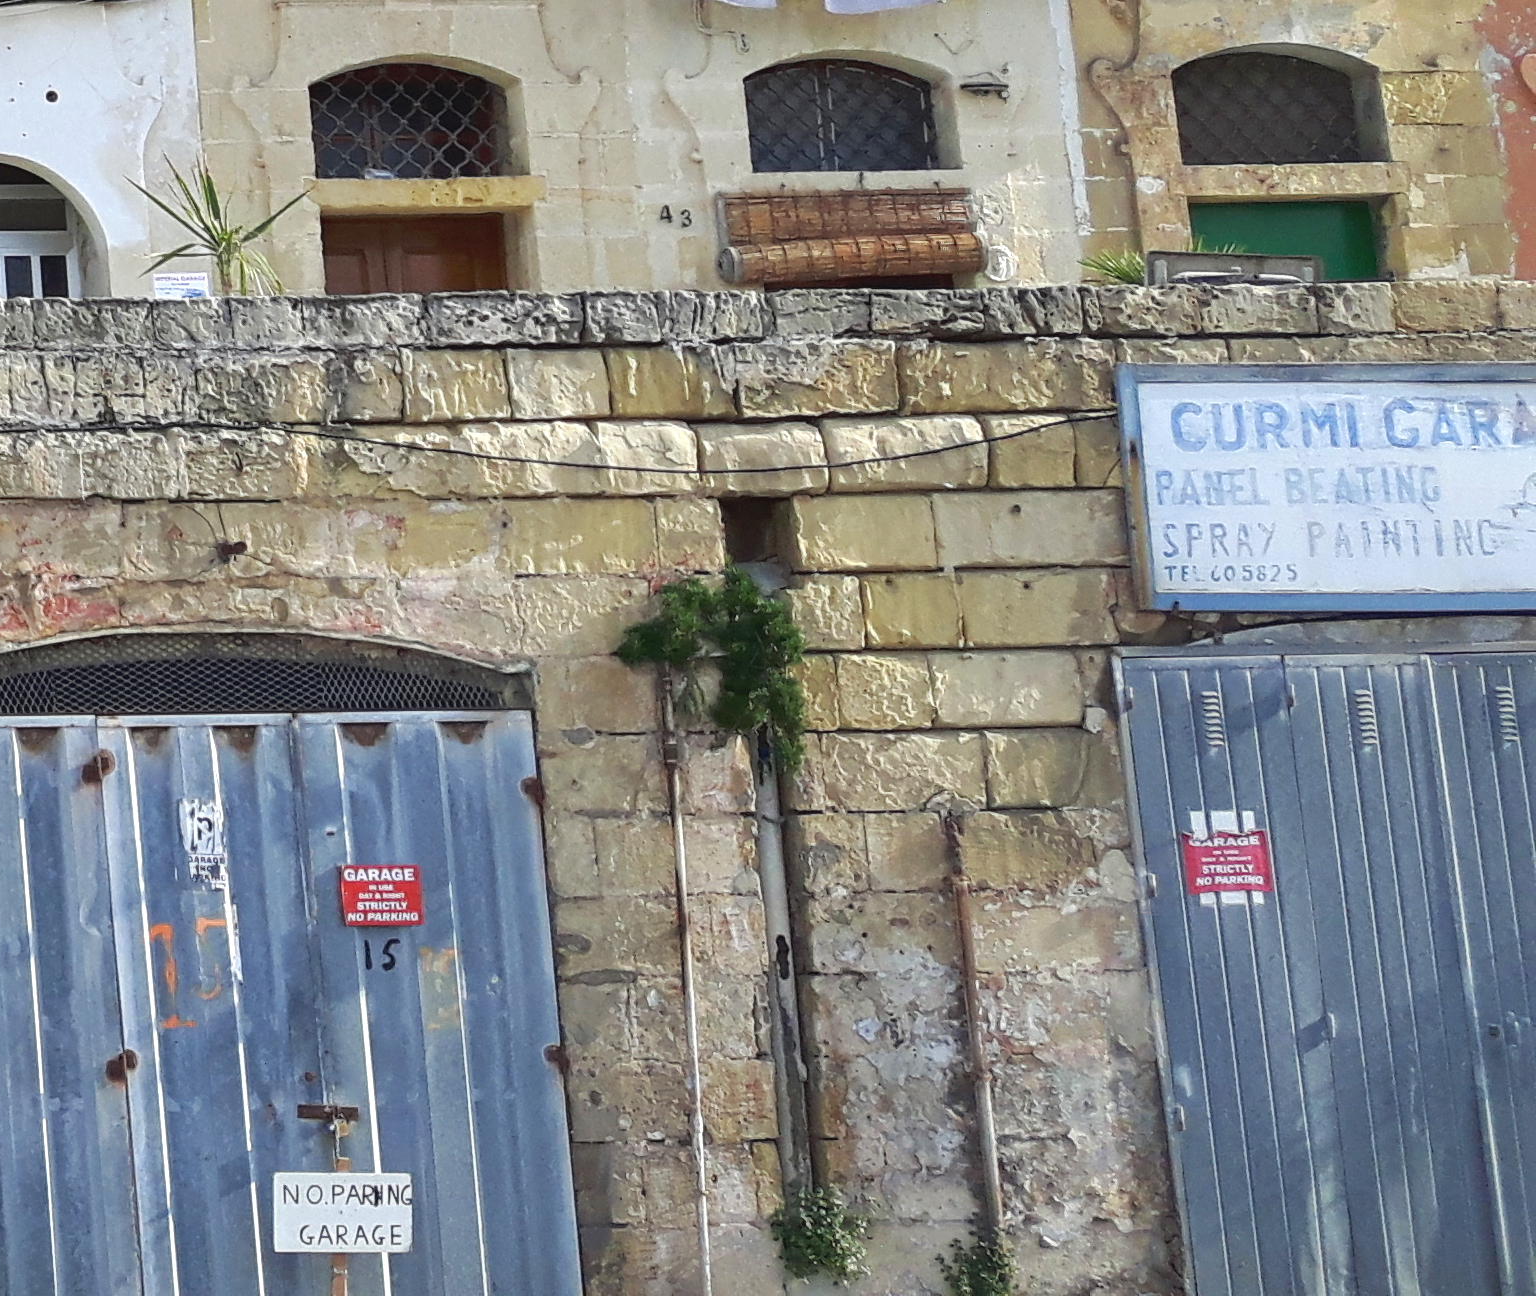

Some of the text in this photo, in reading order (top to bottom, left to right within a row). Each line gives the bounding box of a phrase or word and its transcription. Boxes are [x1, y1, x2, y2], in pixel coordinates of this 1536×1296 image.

[1171, 399, 1360, 452] CURMI
[1155, 465, 1441, 506] PANEL BEATING
[1162, 522, 1276, 558] SPRAY
[343, 868, 415, 881] GARAGE
[1202, 864, 1254, 874] STRICTLY
[1195, 875, 1264, 886] NO PARKING
[356, 901, 407, 910] STRICTLY
[347, 912, 419, 921] NO PARKING
[364, 938, 401, 972] 15
[299, 1224, 403, 1246] GARAGE
